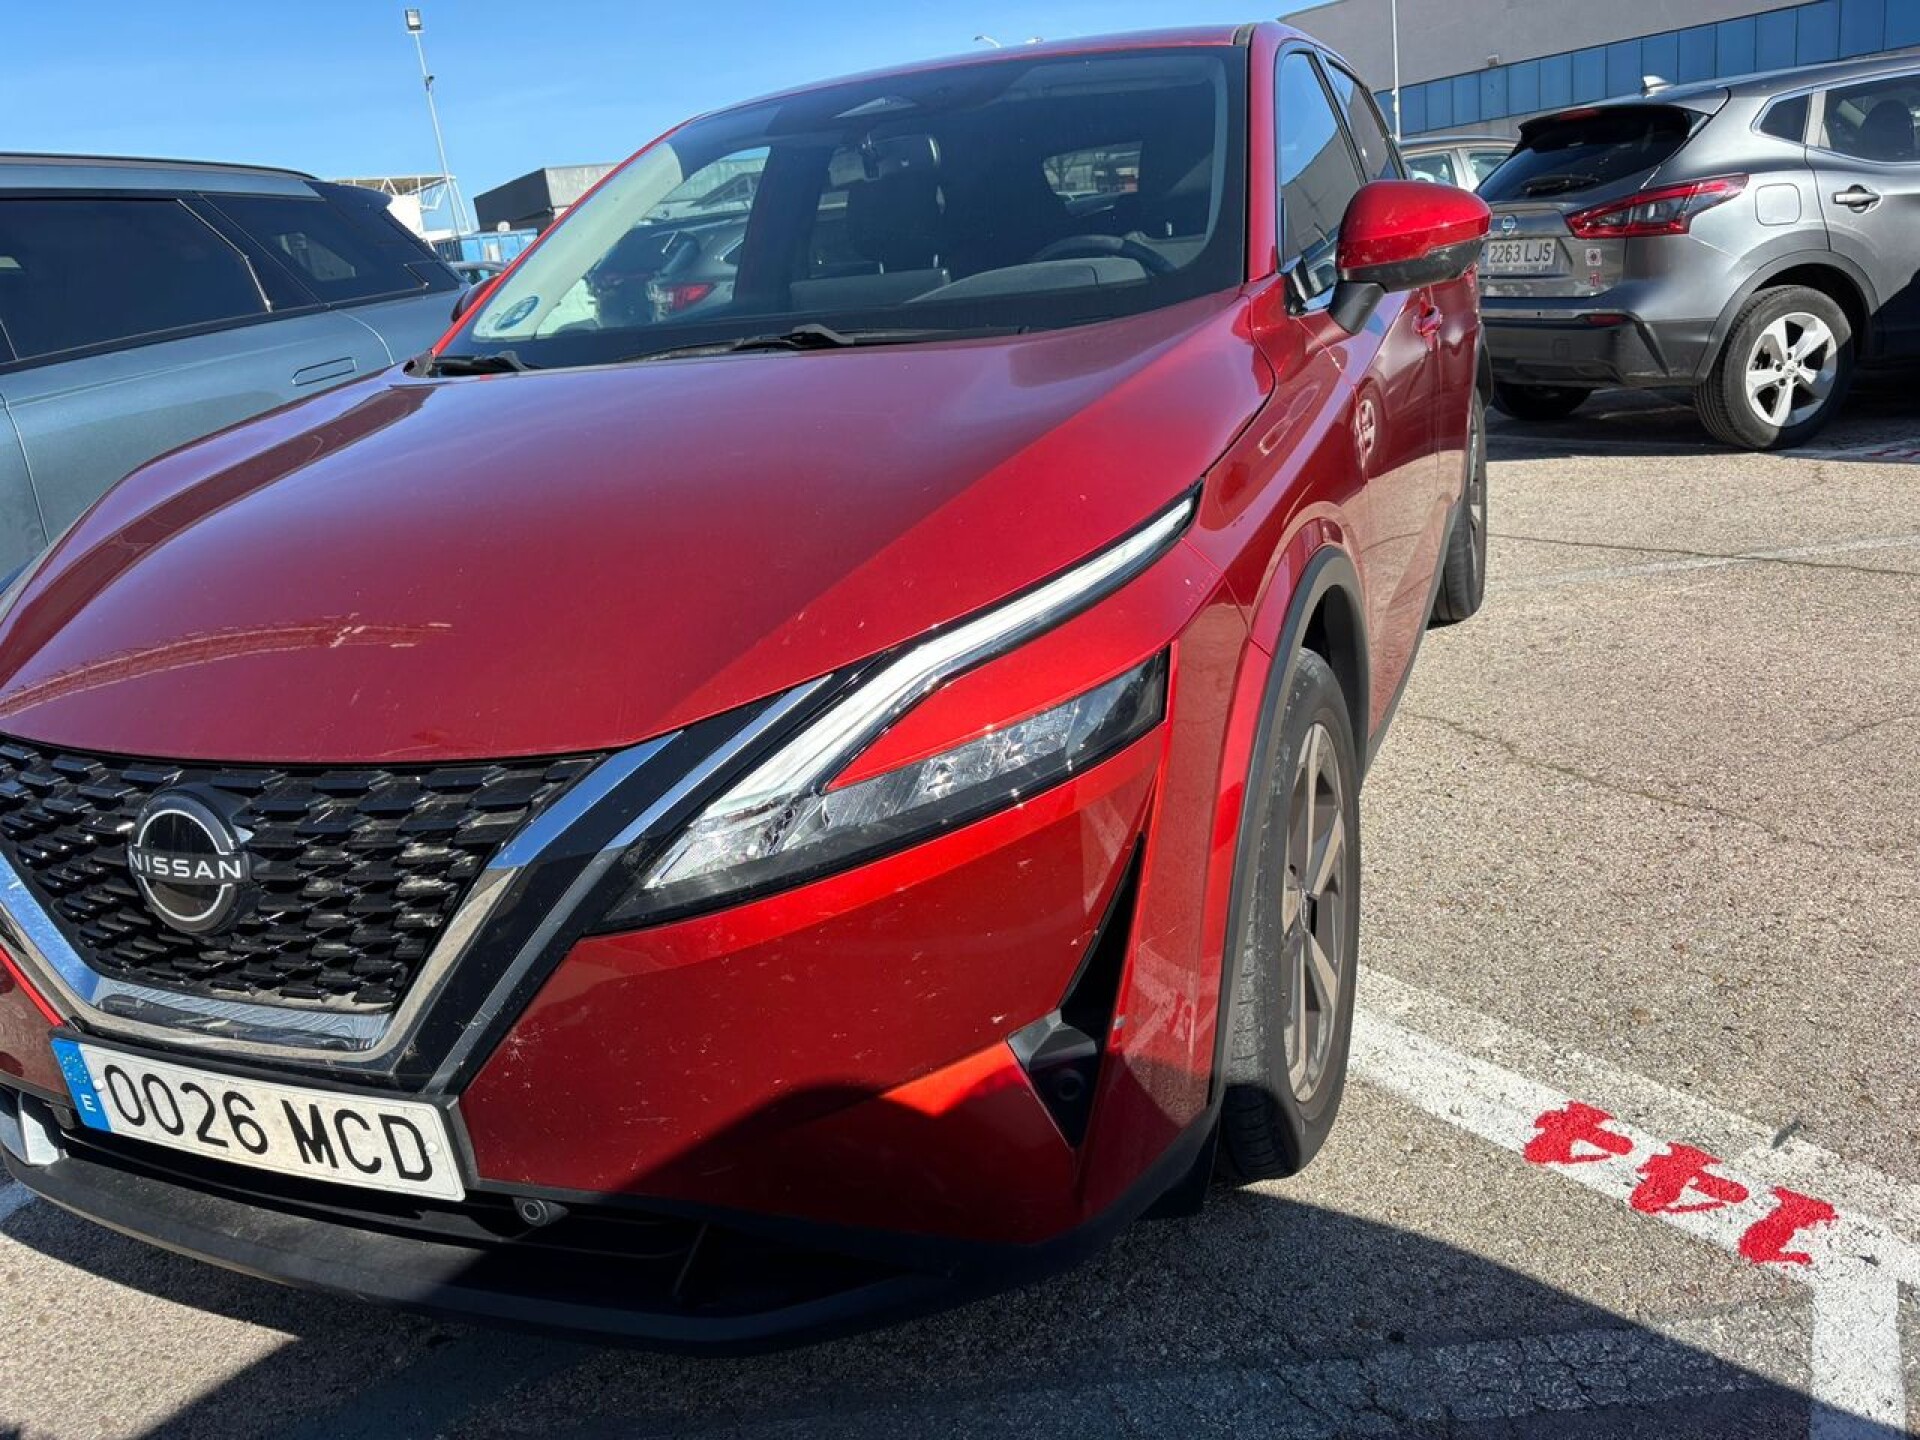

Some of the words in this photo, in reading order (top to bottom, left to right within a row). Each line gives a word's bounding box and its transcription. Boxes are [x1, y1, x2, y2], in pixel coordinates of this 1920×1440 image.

[1490, 244, 1520, 263] 2263
[128, 846, 242, 879] NISSAN
[80, 1094, 97, 1112] E
[104, 1064, 268, 1155] 0026
[281, 1099, 433, 1182] MCD
